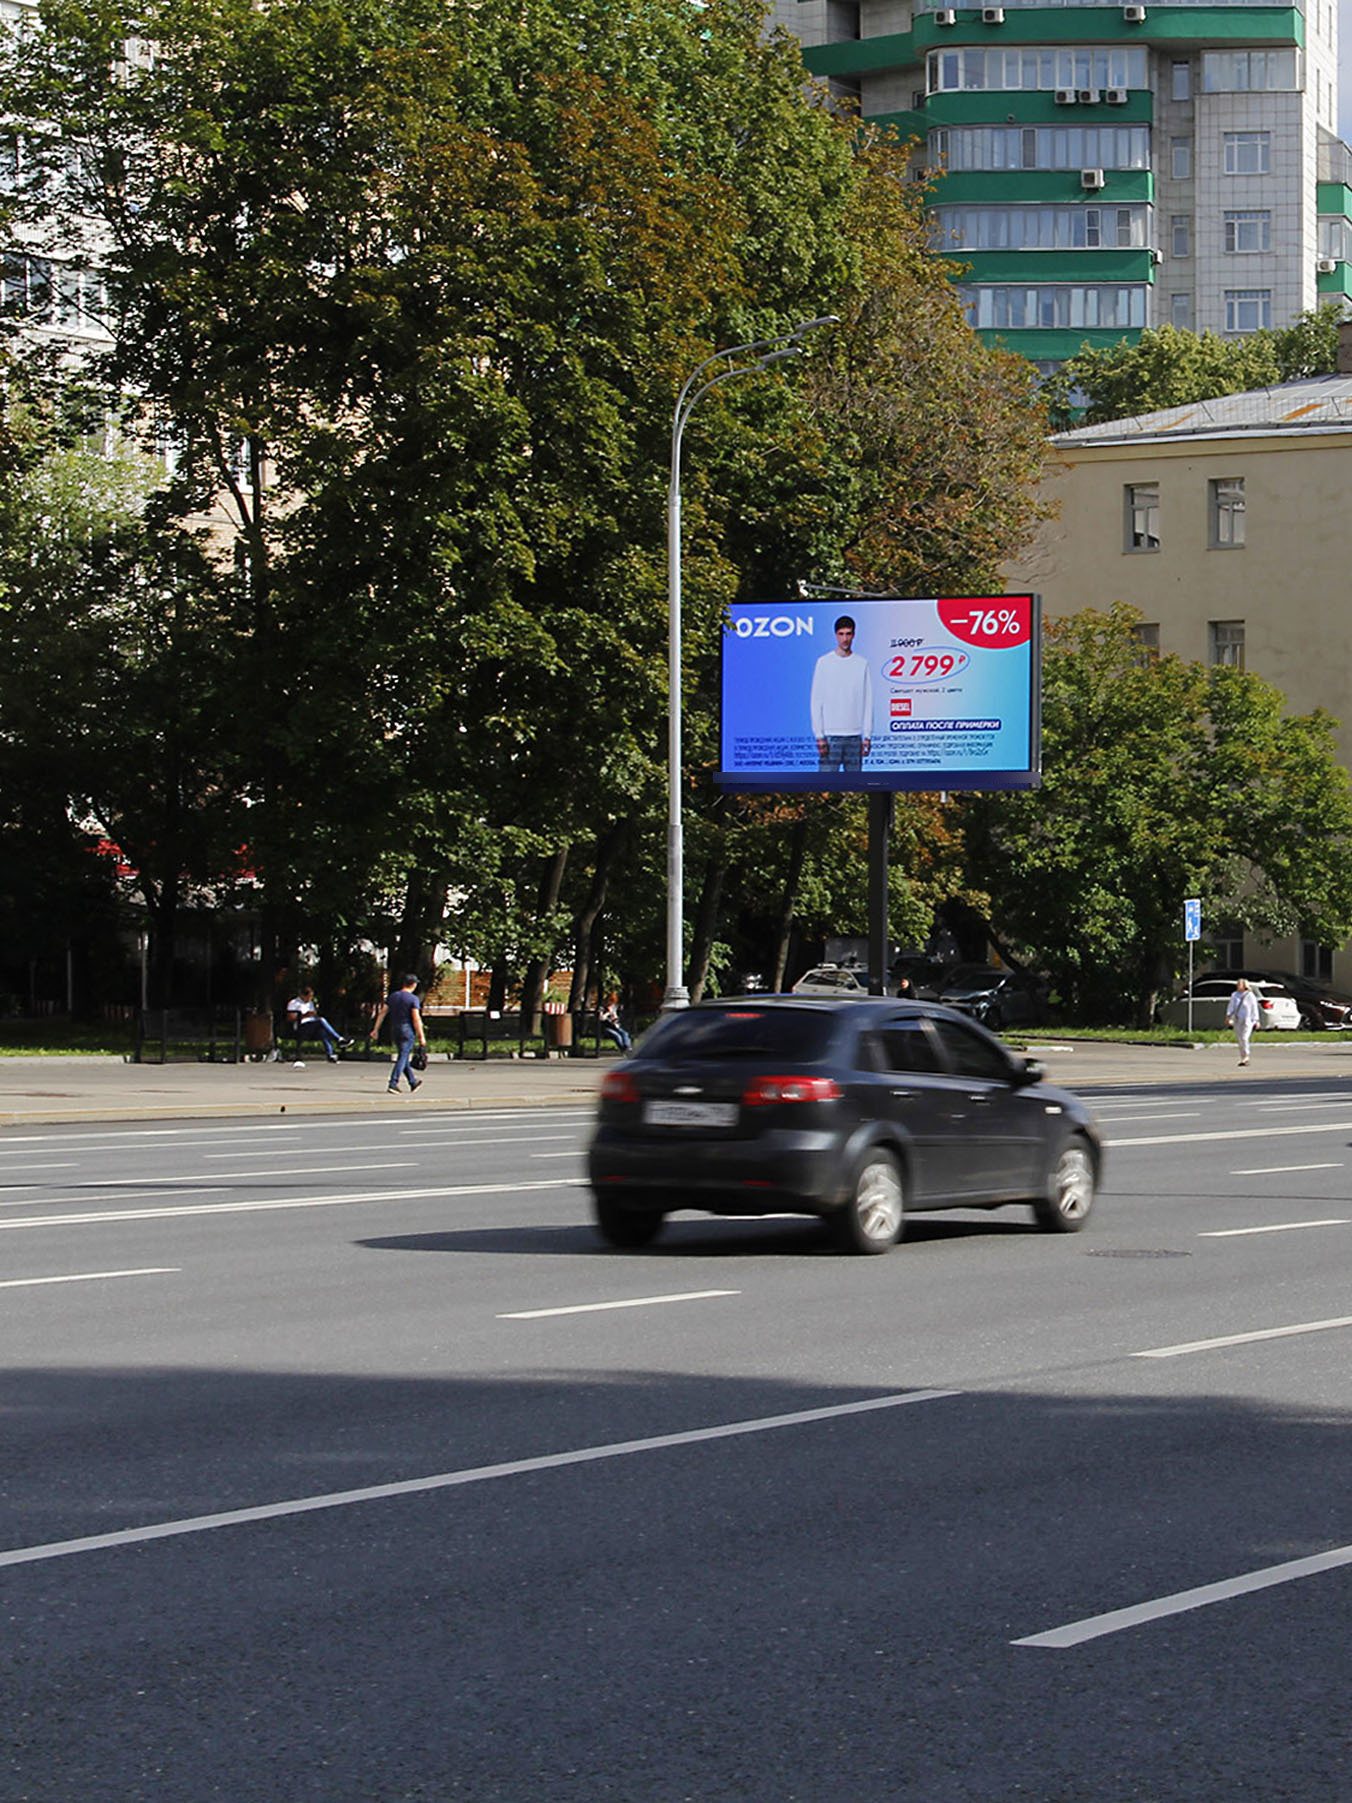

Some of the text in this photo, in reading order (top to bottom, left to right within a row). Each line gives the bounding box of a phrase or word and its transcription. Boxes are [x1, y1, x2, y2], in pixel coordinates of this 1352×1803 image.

[735, 617, 814, 638] OZON
[889, 655, 906, 677] 2
[909, 655, 954, 677] 799
[891, 721, 925, 731] ОПЛАТА
[925, 721, 954, 730] ПОСЛЕ
